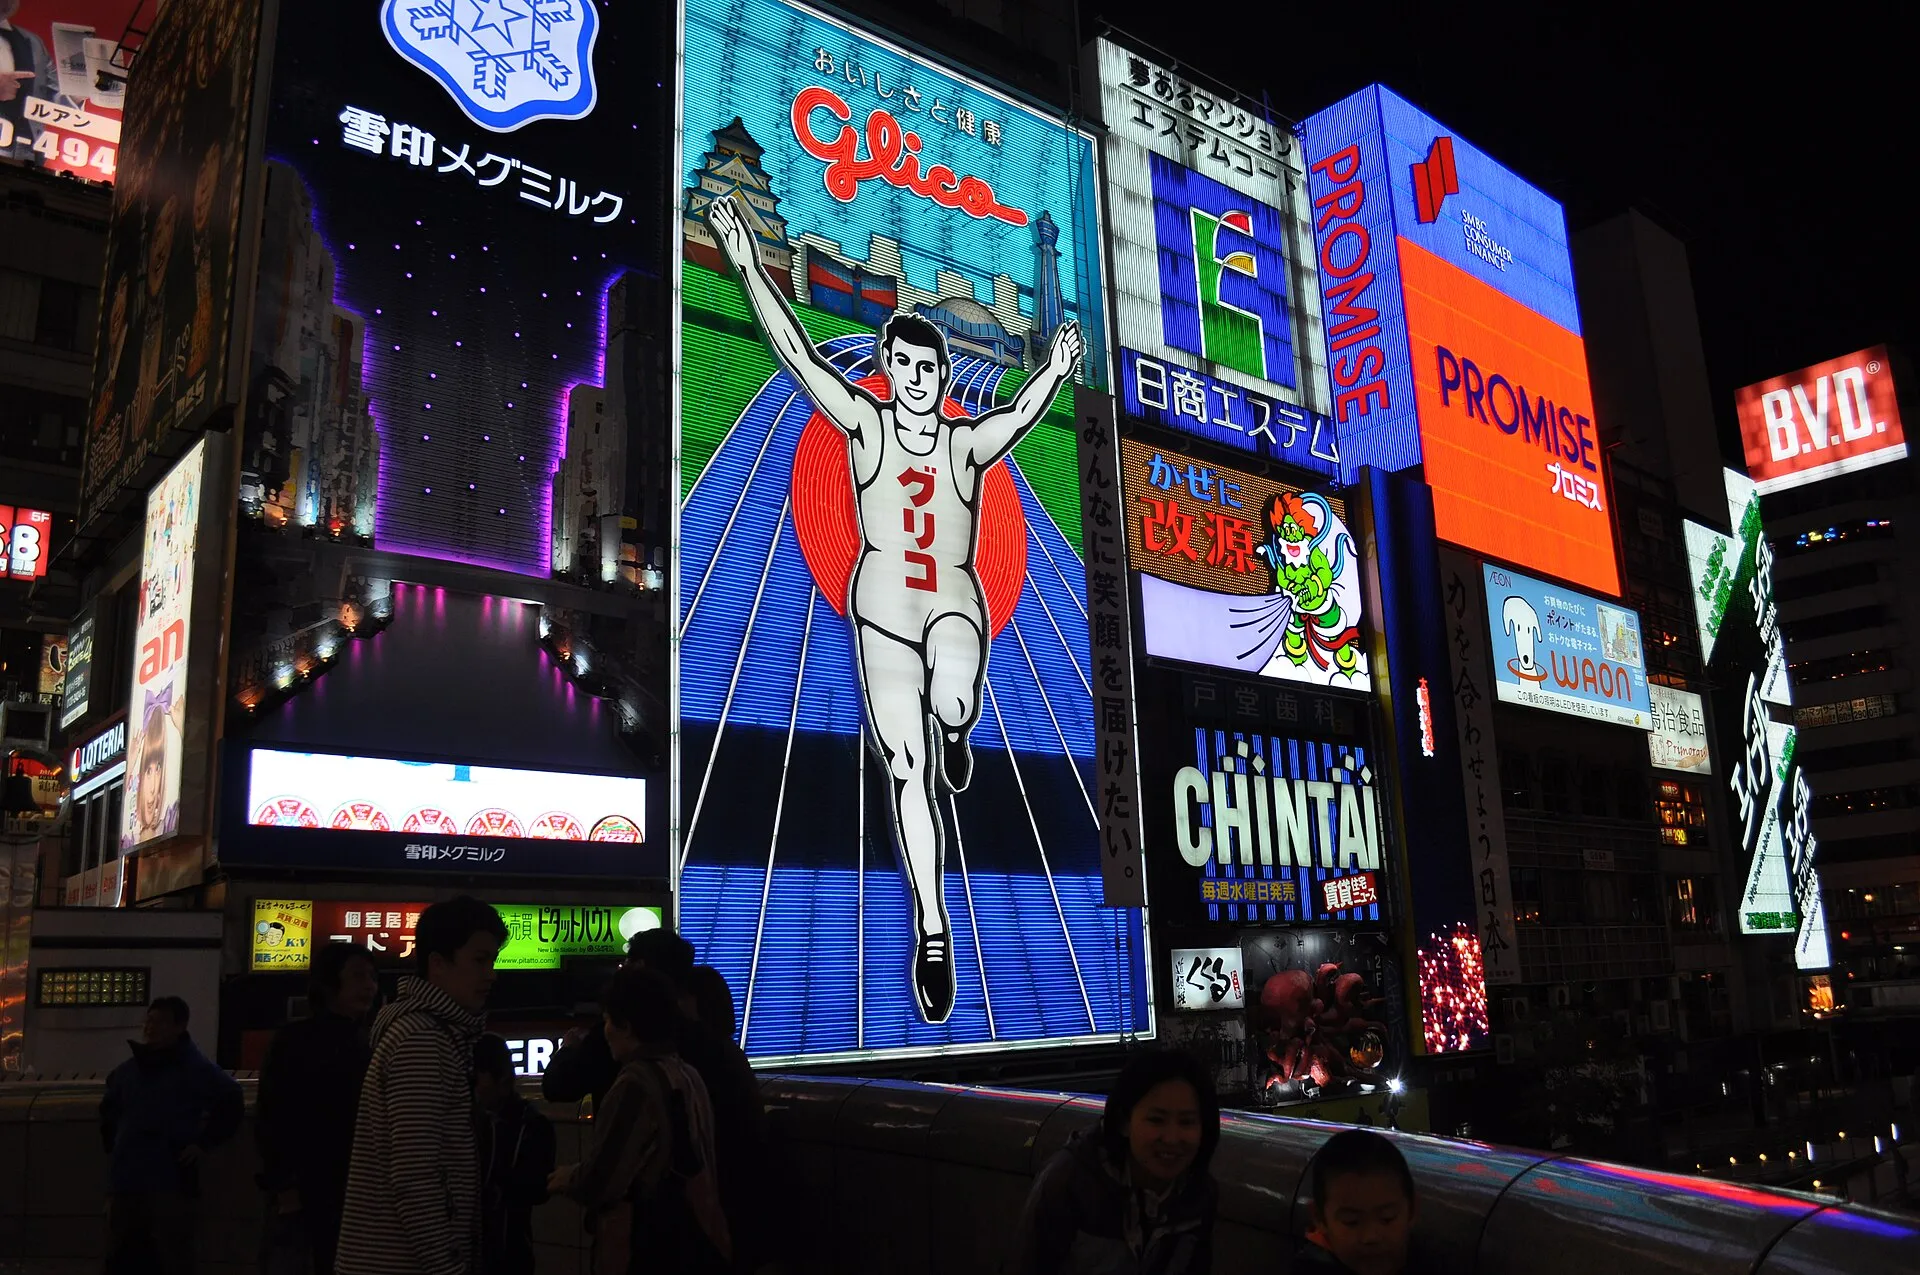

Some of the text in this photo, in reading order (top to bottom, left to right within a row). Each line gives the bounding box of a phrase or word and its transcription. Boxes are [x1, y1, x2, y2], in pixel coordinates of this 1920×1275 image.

[31, 104, 91, 128] ルアン
[813, 46, 1003, 146] おいしさと健康
[1128, 57, 1292, 157] 夢あるマンション
[339, 105, 623, 224] 雪印メグミルク
[791, 85, 1029, 227] Glico
[1131, 98, 1297, 196] エステムコート
[1461, 209, 1488, 235] SMBC
[1463, 224, 1513, 264] CONSUMER
[1465, 237, 1506, 272] FINANCE
[1311, 144, 1391, 424] PROMISE
[1136, 357, 1341, 464] 日商エステム
[1434, 345, 1598, 473] PROMISE
[1147, 453, 1243, 510] かぜに
[1546, 462, 1603, 512] プロミス
[31, 511, 50, 522] 5F
[896, 465, 938, 593] グリコ
[1140, 496, 1257, 573] 改源
[139, 618, 185, 686] an
[1082, 416, 1135, 879] みんなに笑顔を届けたい。
[1551, 650, 1632, 702] WAON
[81, 721, 125, 772] LOTTERIA
[1447, 571, 1509, 963] 力を合わせよう日本
[1174, 744, 1379, 870] CHINTAI
[404, 844, 506, 862] 雪印メグミルク
[1202, 880, 1296, 902] 毎週水曜日発売
[1323, 878, 1353, 911] 賃貸
[1353, 887, 1377, 904] ニュース
[538, 906, 615, 943] ピタットハウス
[255, 953, 308, 963] 関西インベスト
[1186, 956, 1231, 1003] くくる
